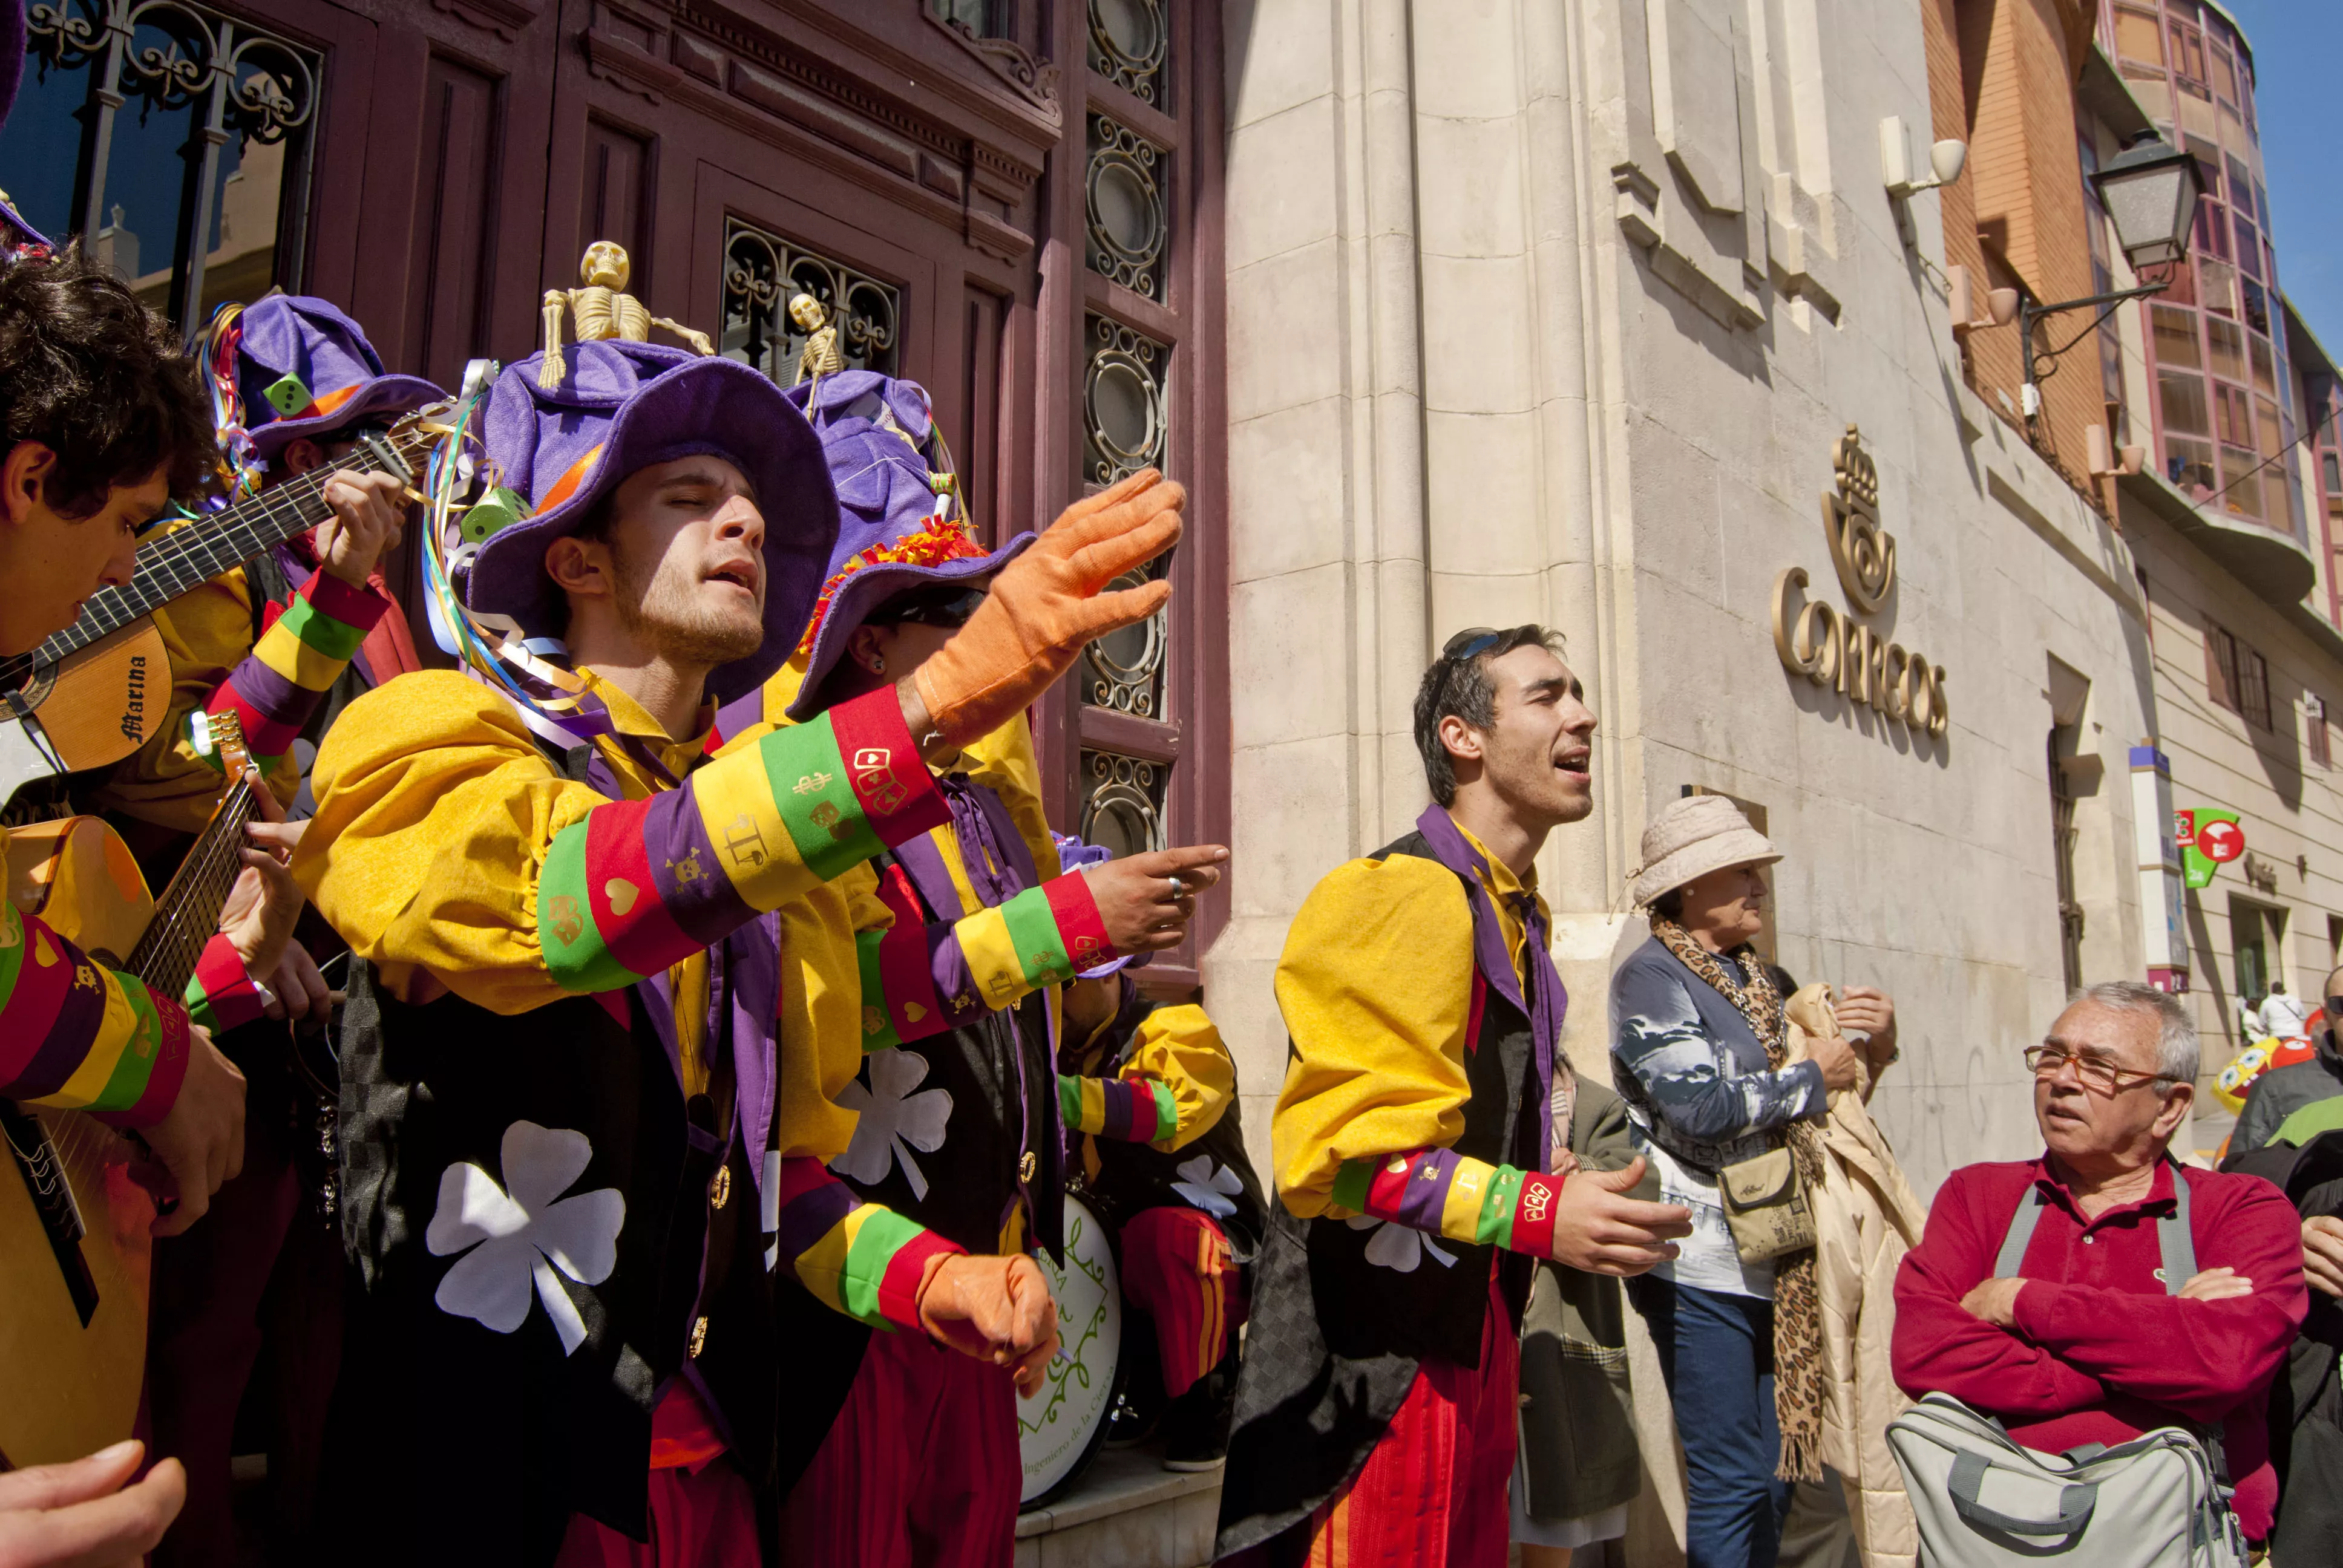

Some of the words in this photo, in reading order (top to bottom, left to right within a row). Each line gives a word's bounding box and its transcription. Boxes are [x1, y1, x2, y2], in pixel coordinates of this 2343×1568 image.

[120, 656, 146, 744] Marina
[1024, 1441, 1069, 1475] Ingeniero
[1072, 1427, 1082, 1441] de
[1081, 1414, 1090, 1425] la
[1091, 1365, 1114, 1411] Cierva
